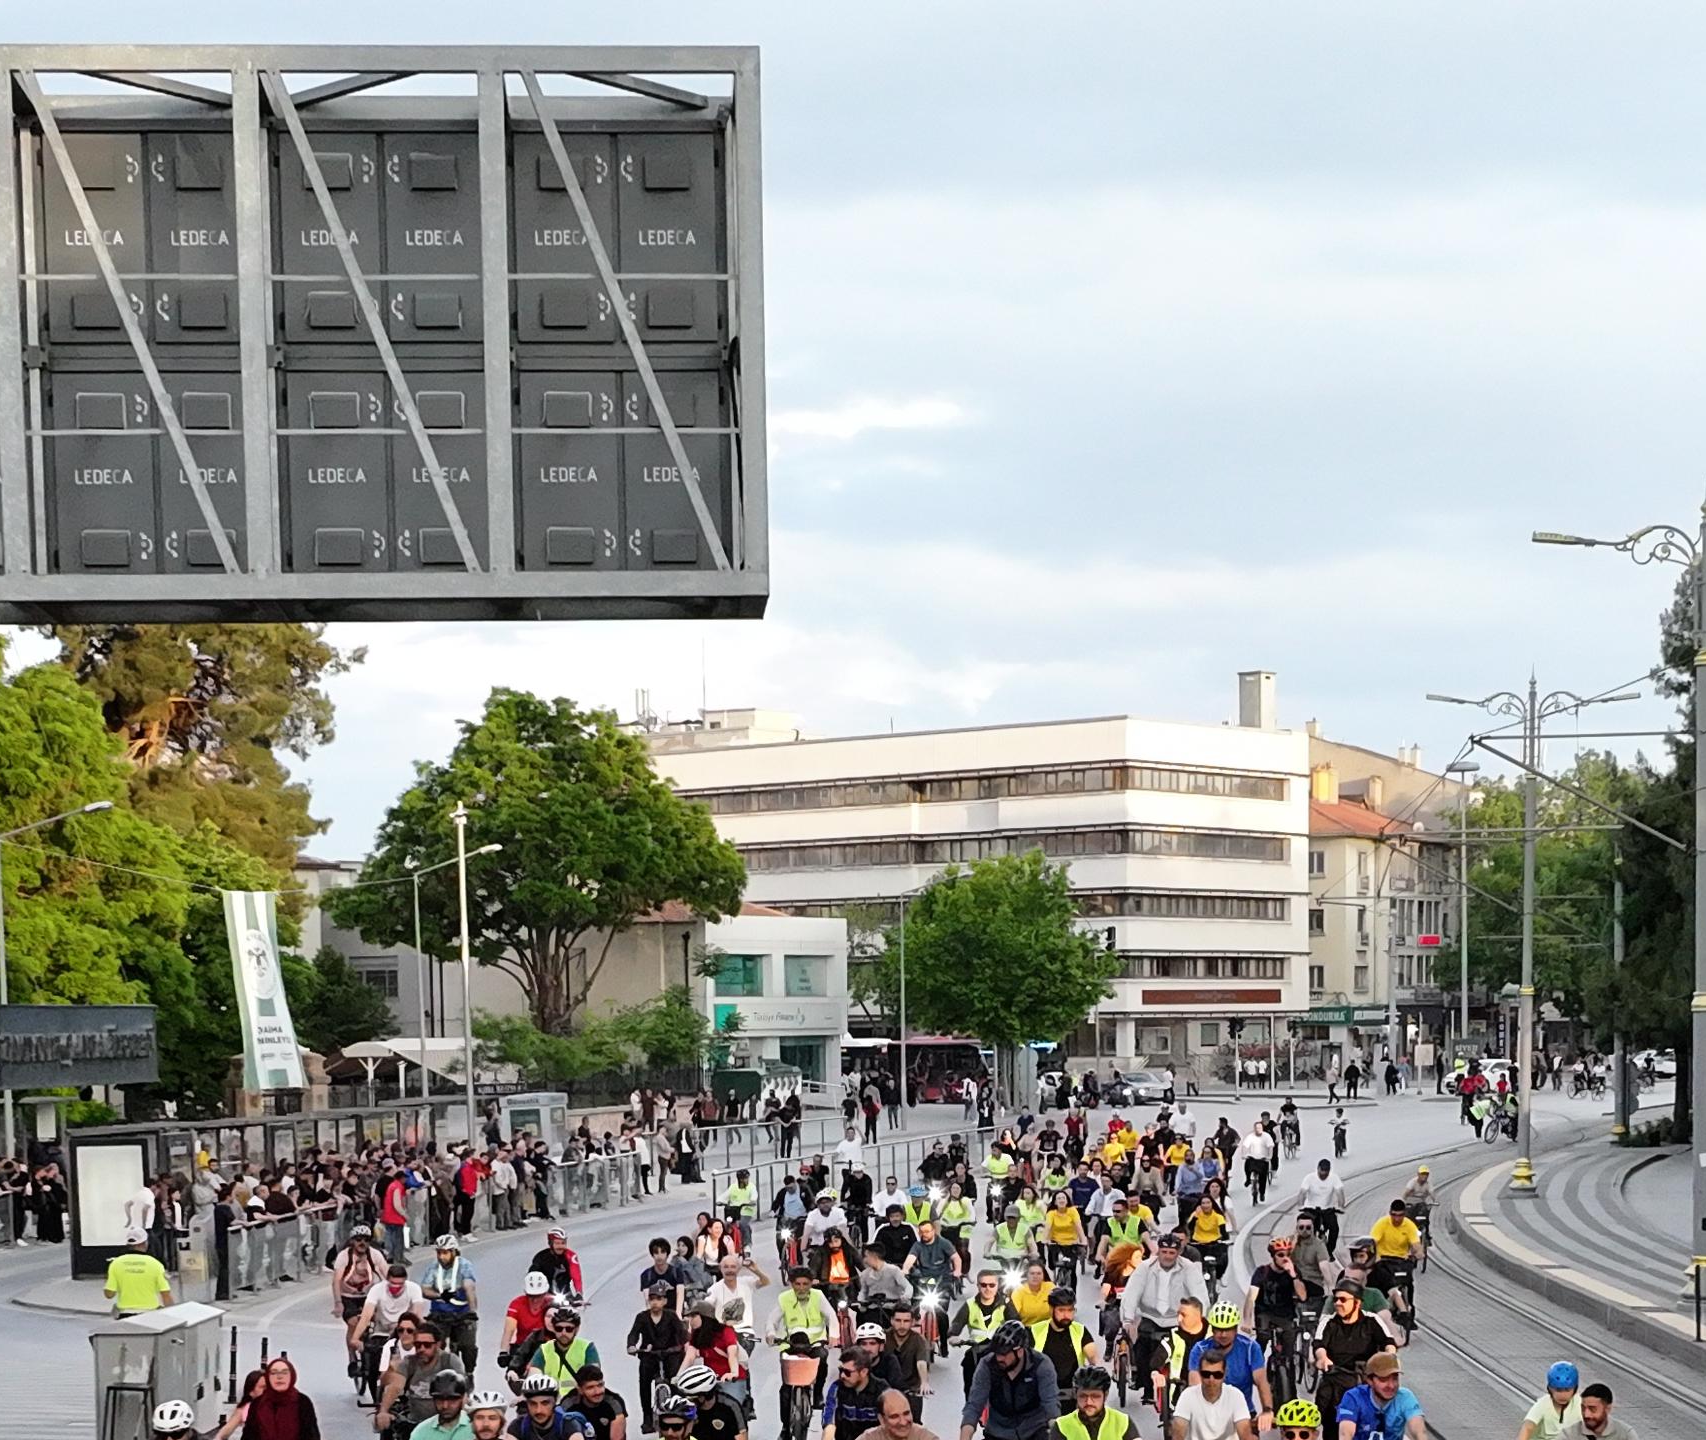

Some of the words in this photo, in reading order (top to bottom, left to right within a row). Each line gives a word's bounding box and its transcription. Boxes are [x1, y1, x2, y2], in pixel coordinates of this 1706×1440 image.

[170, 229, 230, 246] LEDECA
[405, 229, 464, 246] LEDECA
[638, 229, 696, 246] LEDECA
[74, 468, 133, 485] LEDECA
[308, 467, 366, 484] LEDECA
[540, 467, 598, 483] LEDECA
